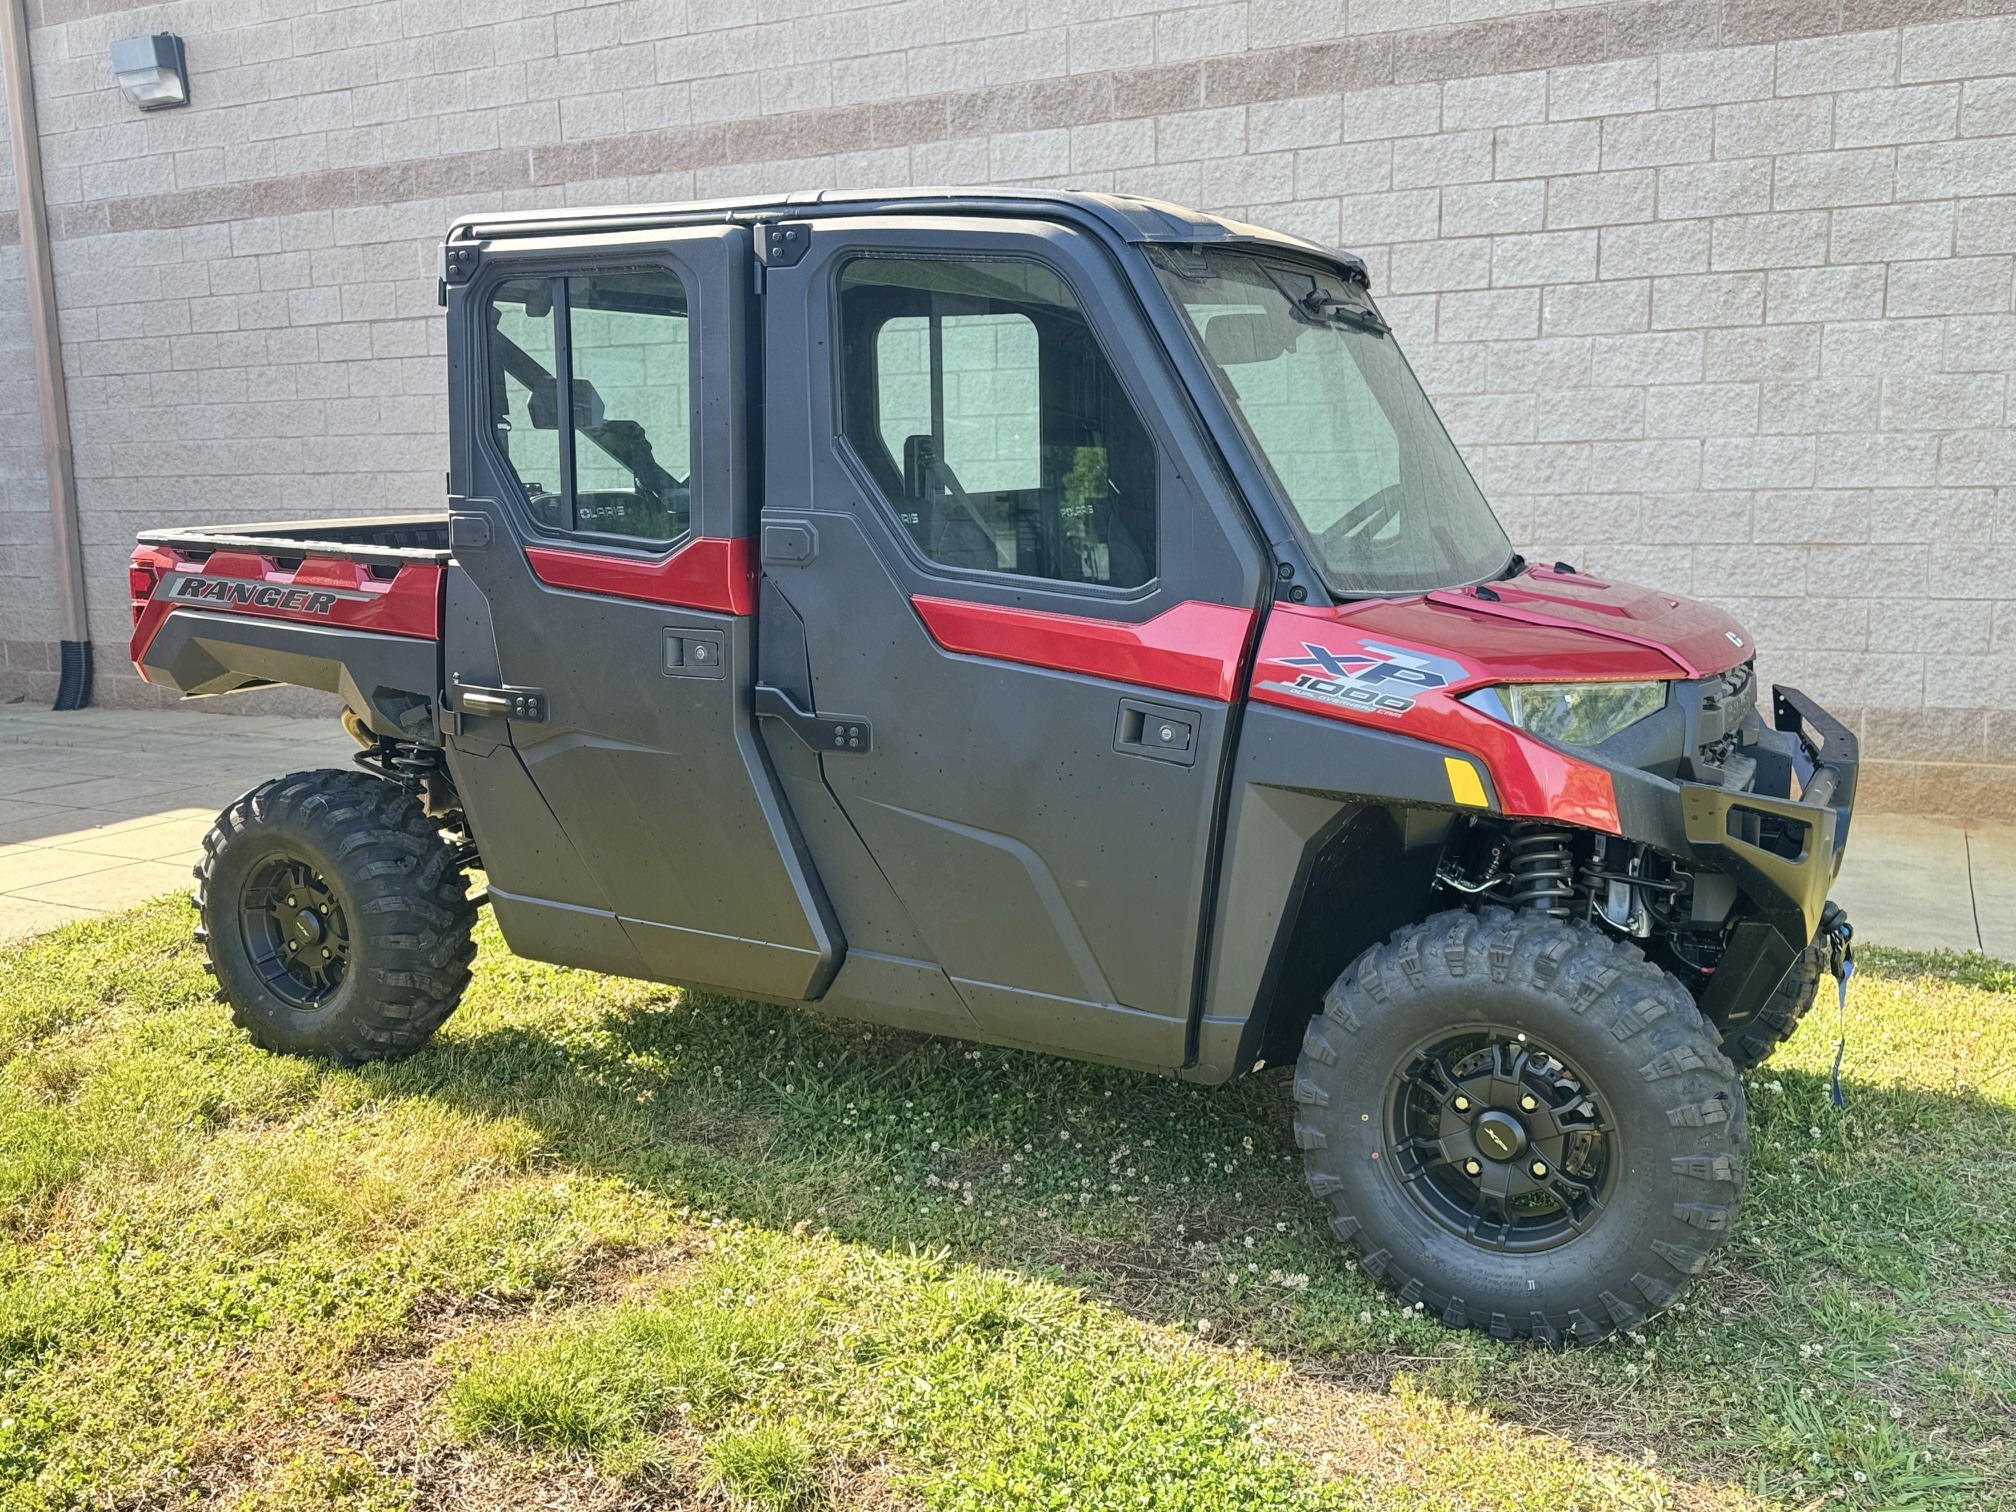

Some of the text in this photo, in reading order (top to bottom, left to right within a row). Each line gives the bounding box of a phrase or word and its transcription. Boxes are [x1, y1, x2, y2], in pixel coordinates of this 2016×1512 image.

[580, 505, 625, 519] OLARIS
[176, 577, 336, 615] RANGER
[1265, 640, 1449, 690] XP
[1289, 688, 1316, 698] DUAL
[1376, 708, 1403, 719] CAM
[1294, 674, 1417, 711] 1000
